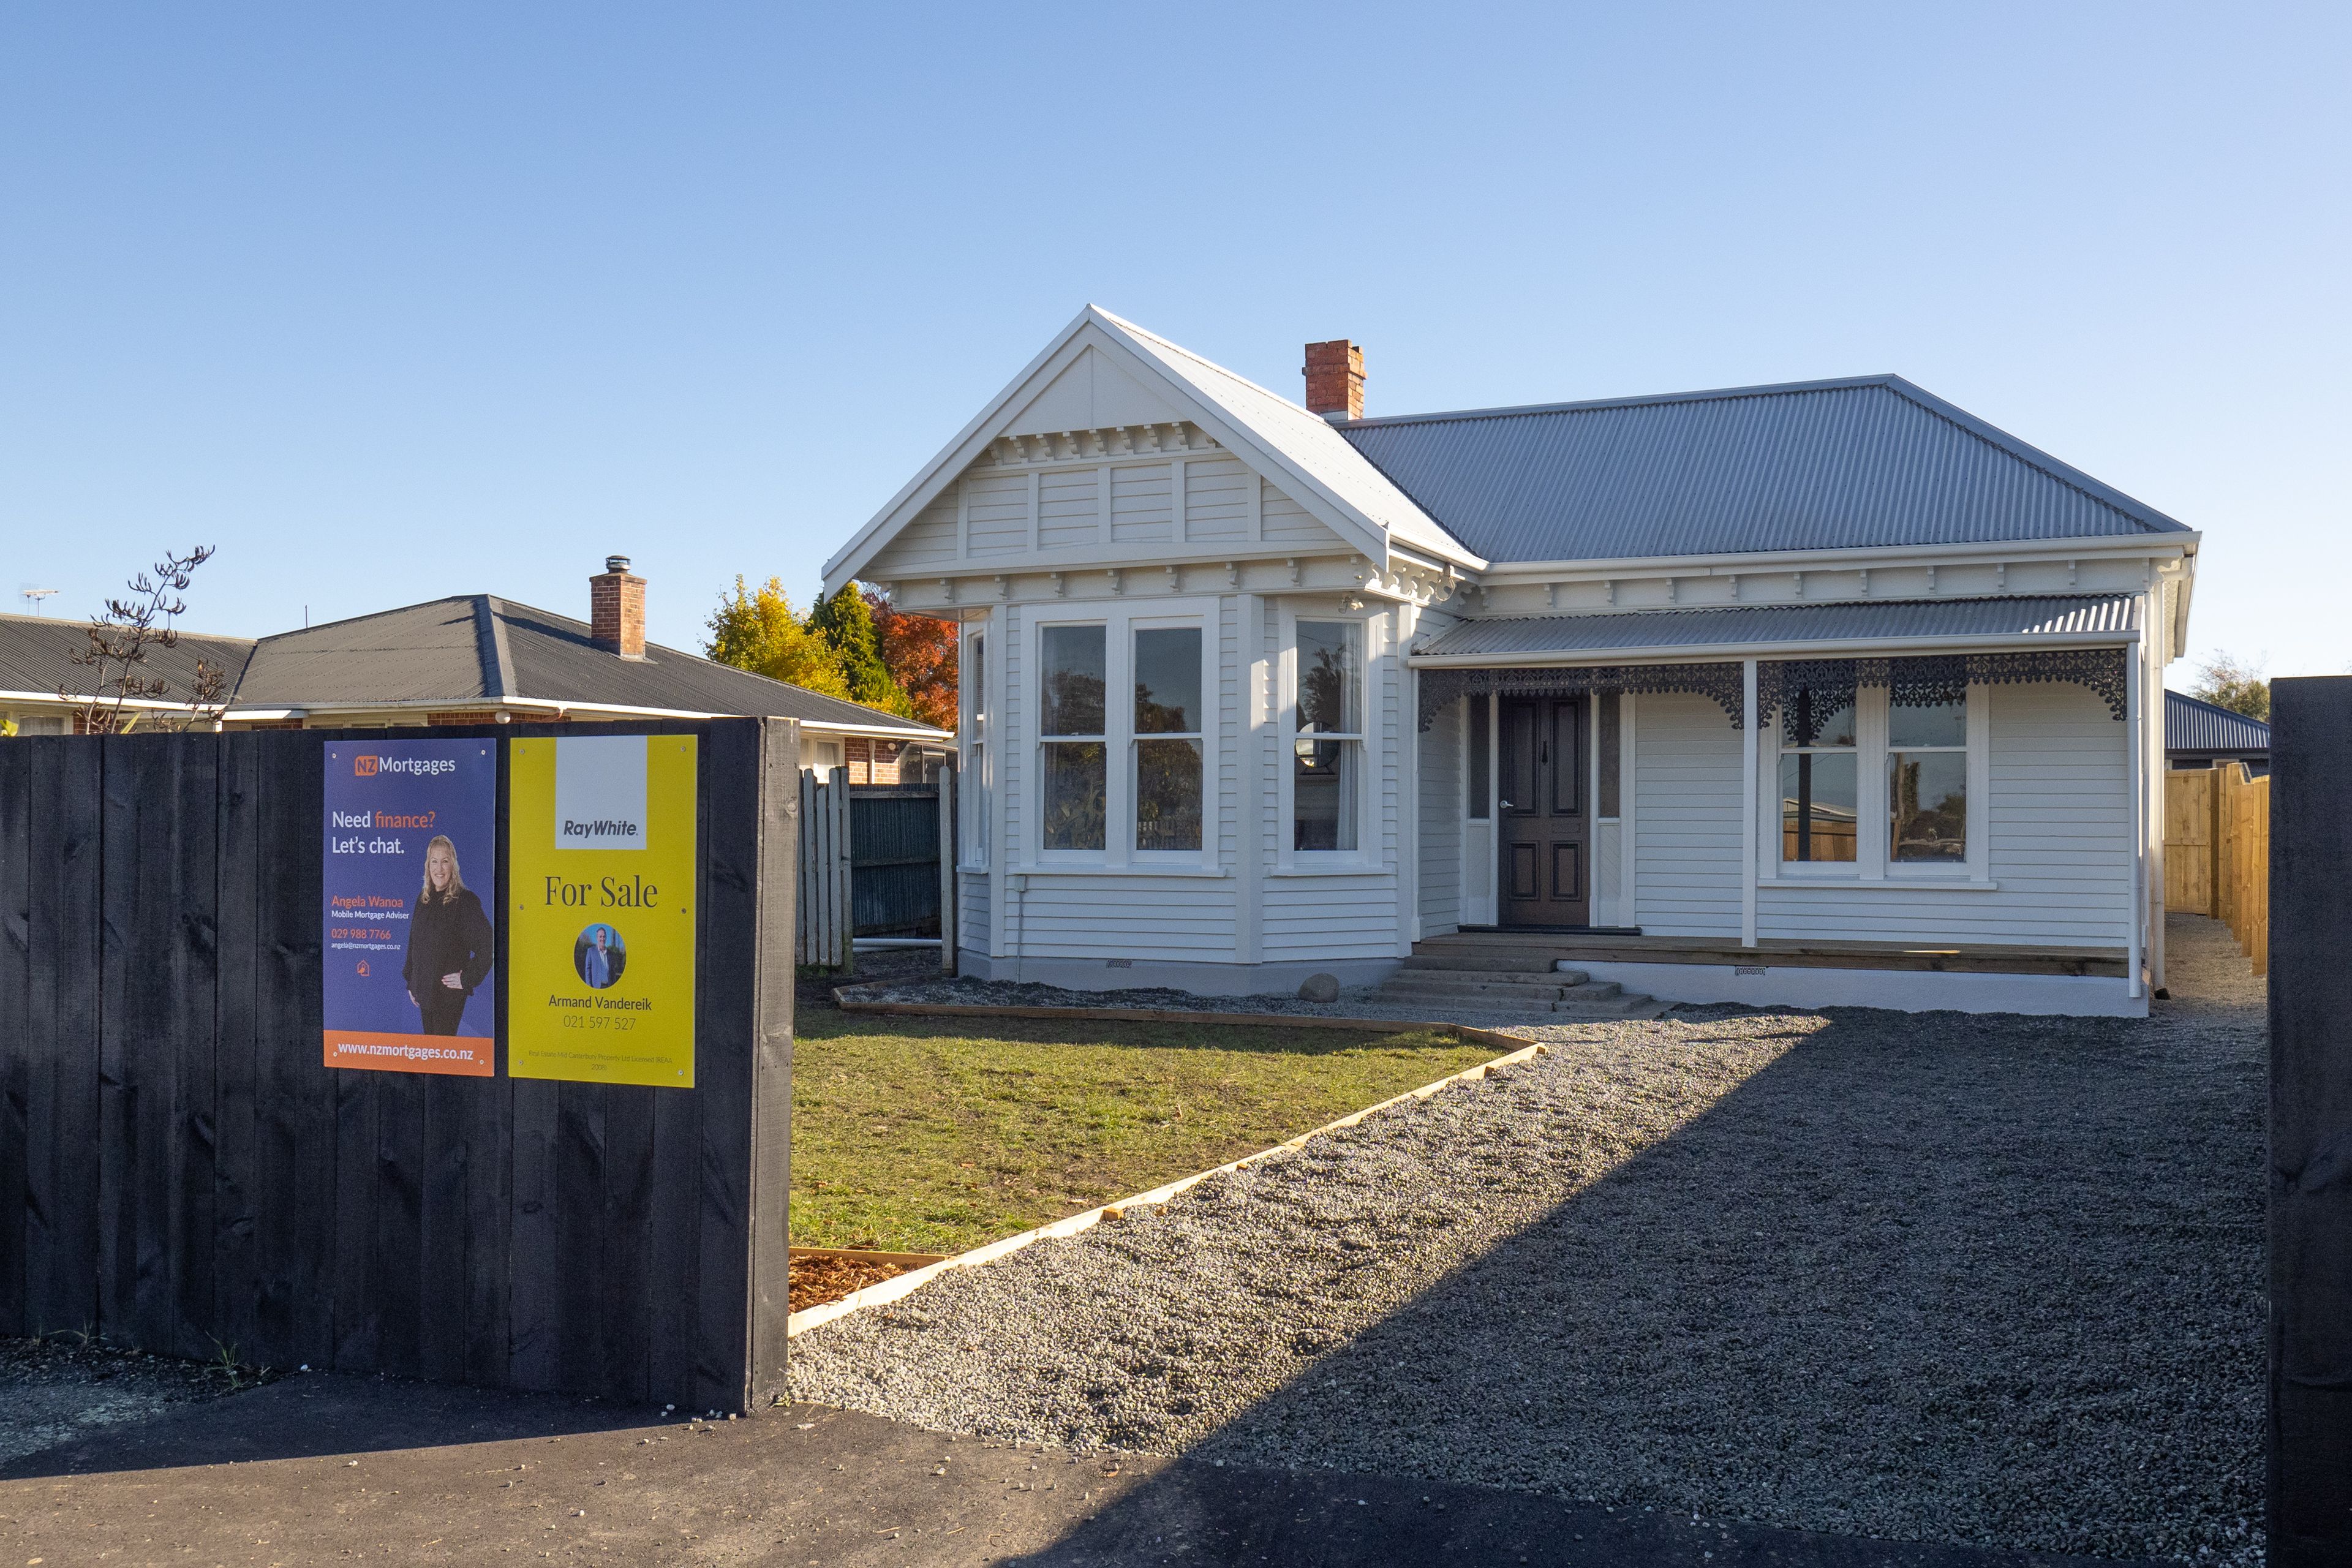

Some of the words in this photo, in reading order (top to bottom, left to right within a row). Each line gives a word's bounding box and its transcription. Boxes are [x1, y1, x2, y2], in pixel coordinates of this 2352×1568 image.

[356, 758, 375, 773] NZ
[379, 756, 456, 775] Mortgages
[332, 811, 371, 827] Need
[375, 810, 435, 827] finance?
[369, 837, 405, 854] chat.
[545, 876, 592, 906] For
[601, 875, 658, 908] Sale
[331, 895, 366, 909] Angela
[368, 895, 404, 908] Wanoa
[355, 911, 385, 920] Mortgage
[331, 929, 348, 938] 029
[350, 929, 367, 939] 988
[369, 929, 391, 940] 7766
[549, 995, 592, 1008] Armand
[595, 997, 652, 1011] Vandereik
[564, 1016, 584, 1028] 021
[589, 1017, 610, 1029] 597
[614, 1018, 636, 1030] 527
[338, 1043, 473, 1060] www.nzmortgages.co.nz
